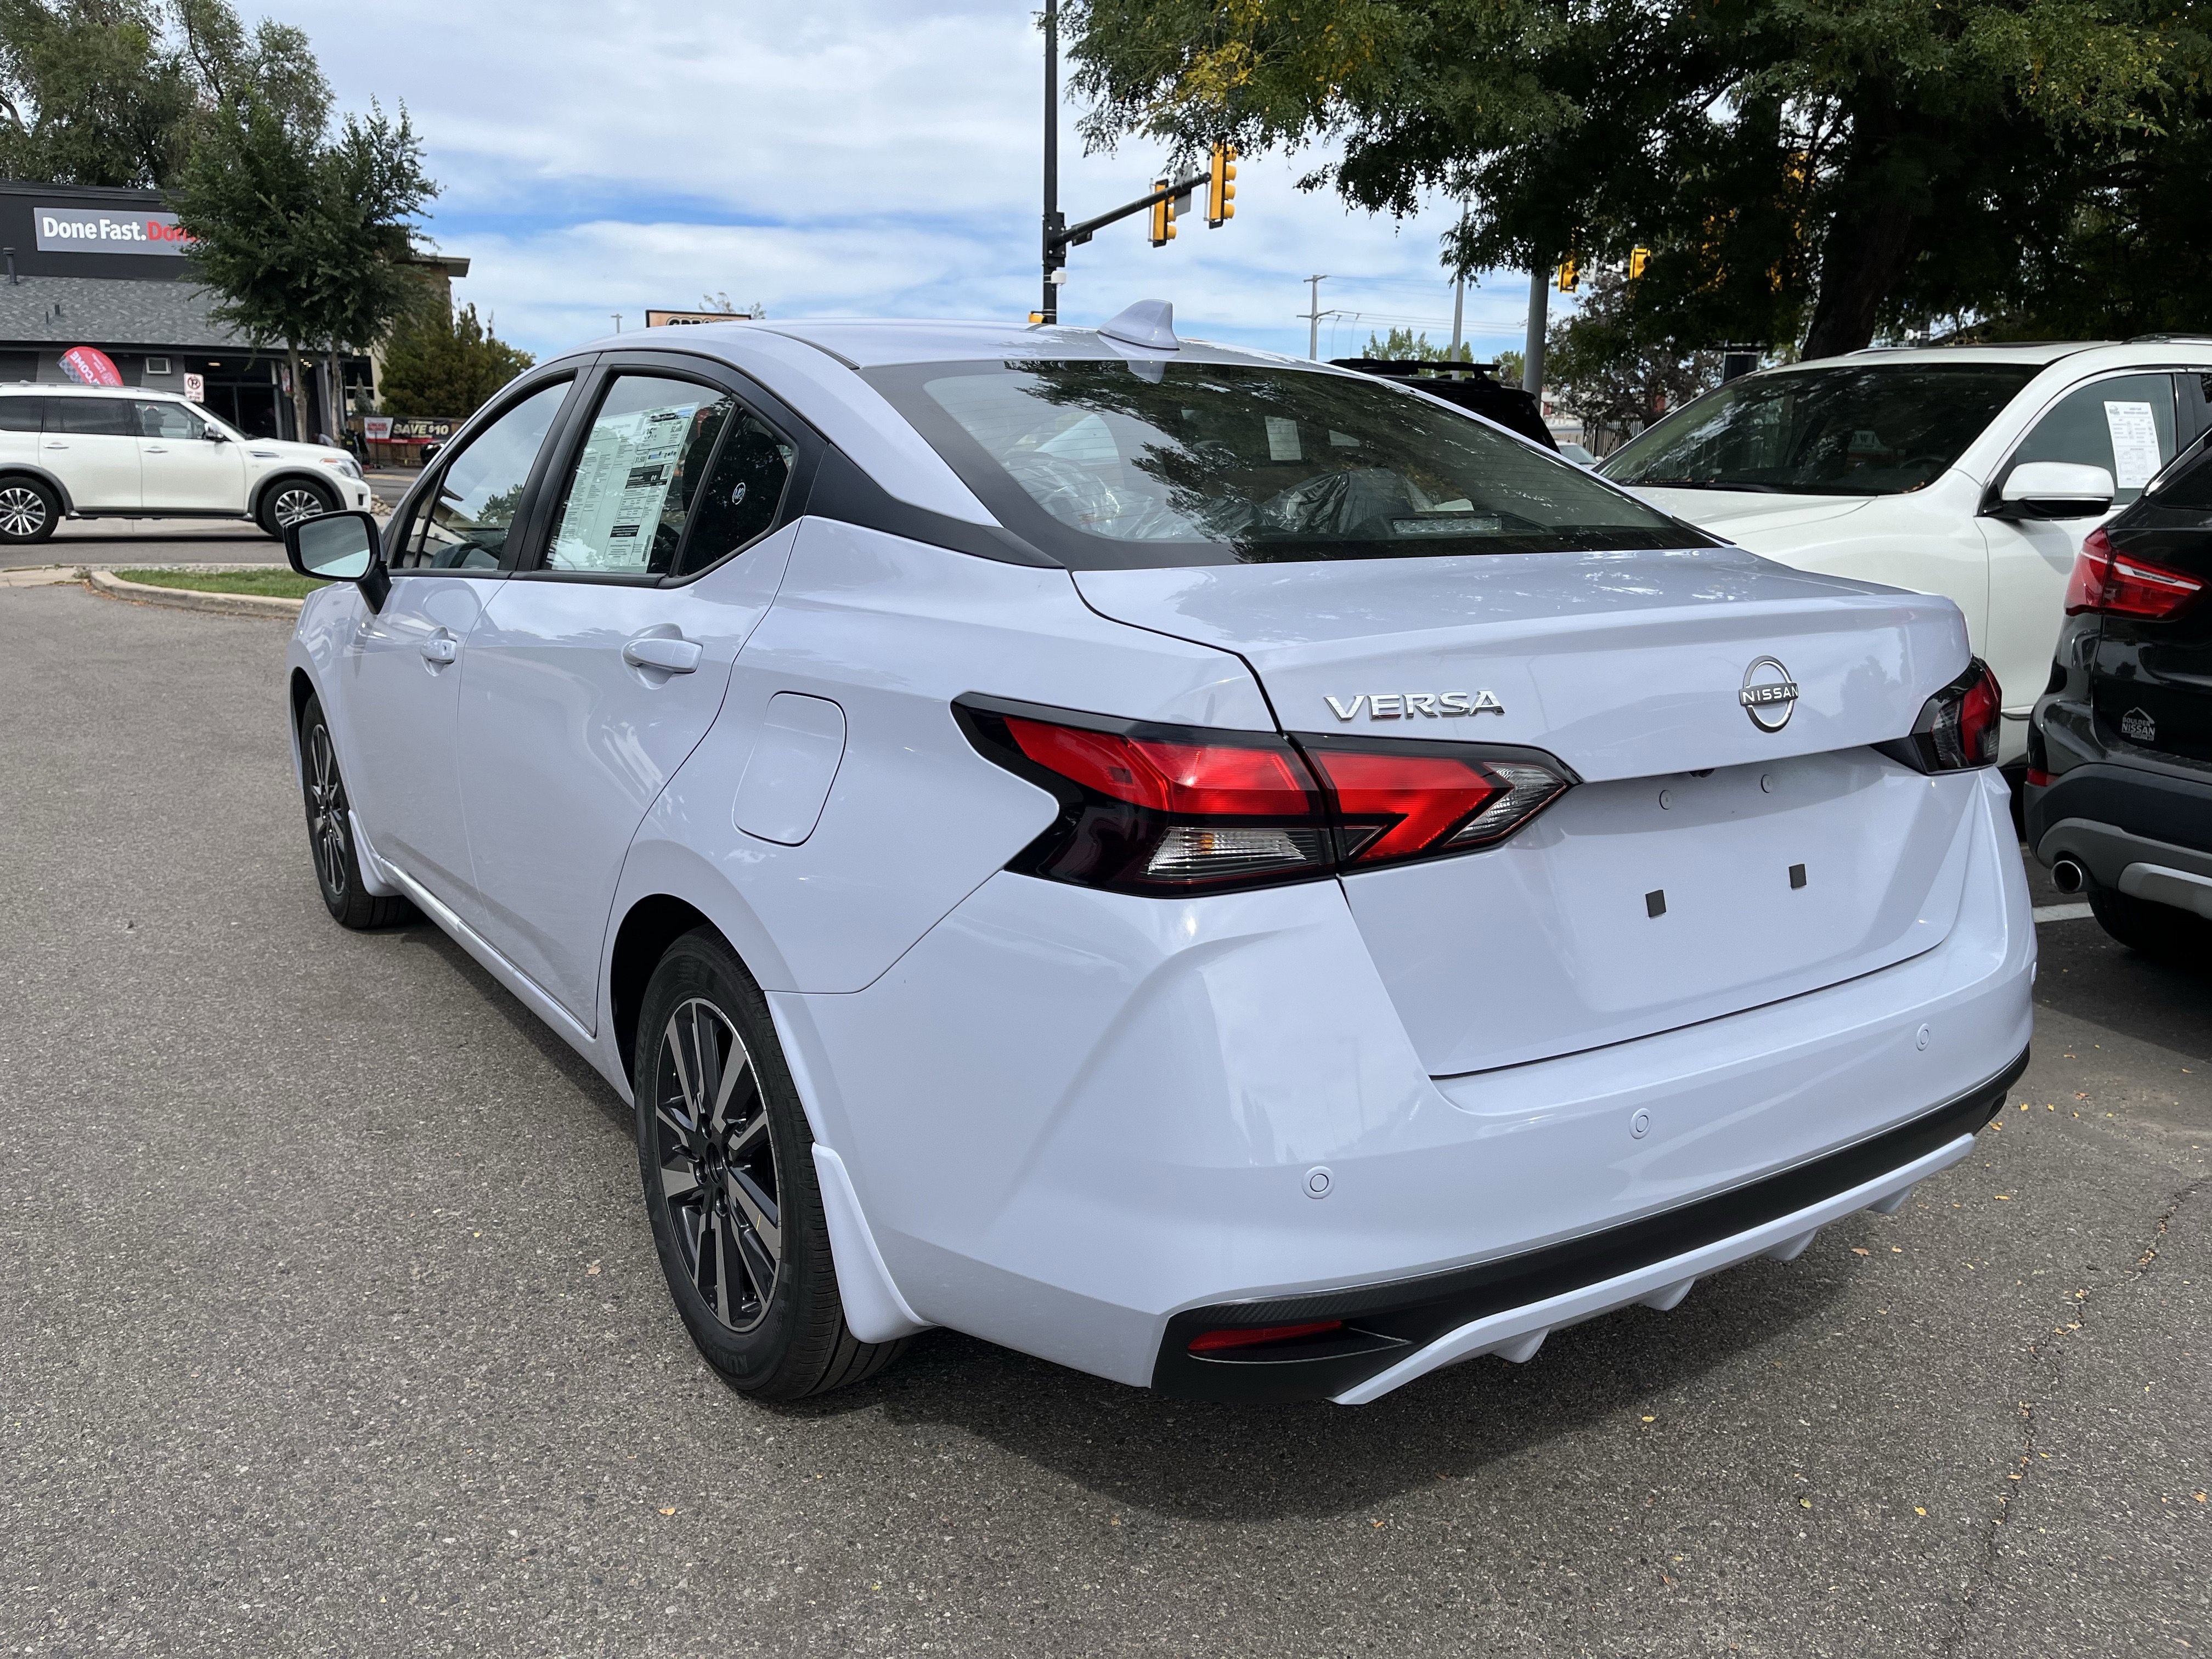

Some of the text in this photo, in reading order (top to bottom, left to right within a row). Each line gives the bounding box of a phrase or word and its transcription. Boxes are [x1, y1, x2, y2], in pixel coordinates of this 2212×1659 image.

[42, 217, 97, 238] Done
[99, 219, 147, 241] Fast.
[393, 423, 427, 435] SAVE
[428, 425, 449, 436] $10
[1742, 686, 1798, 703] NISSAN
[1323, 690, 1505, 723] VERSA
[2123, 716, 2151, 727] BOULDER
[2122, 724, 2155, 736] NISSAN
